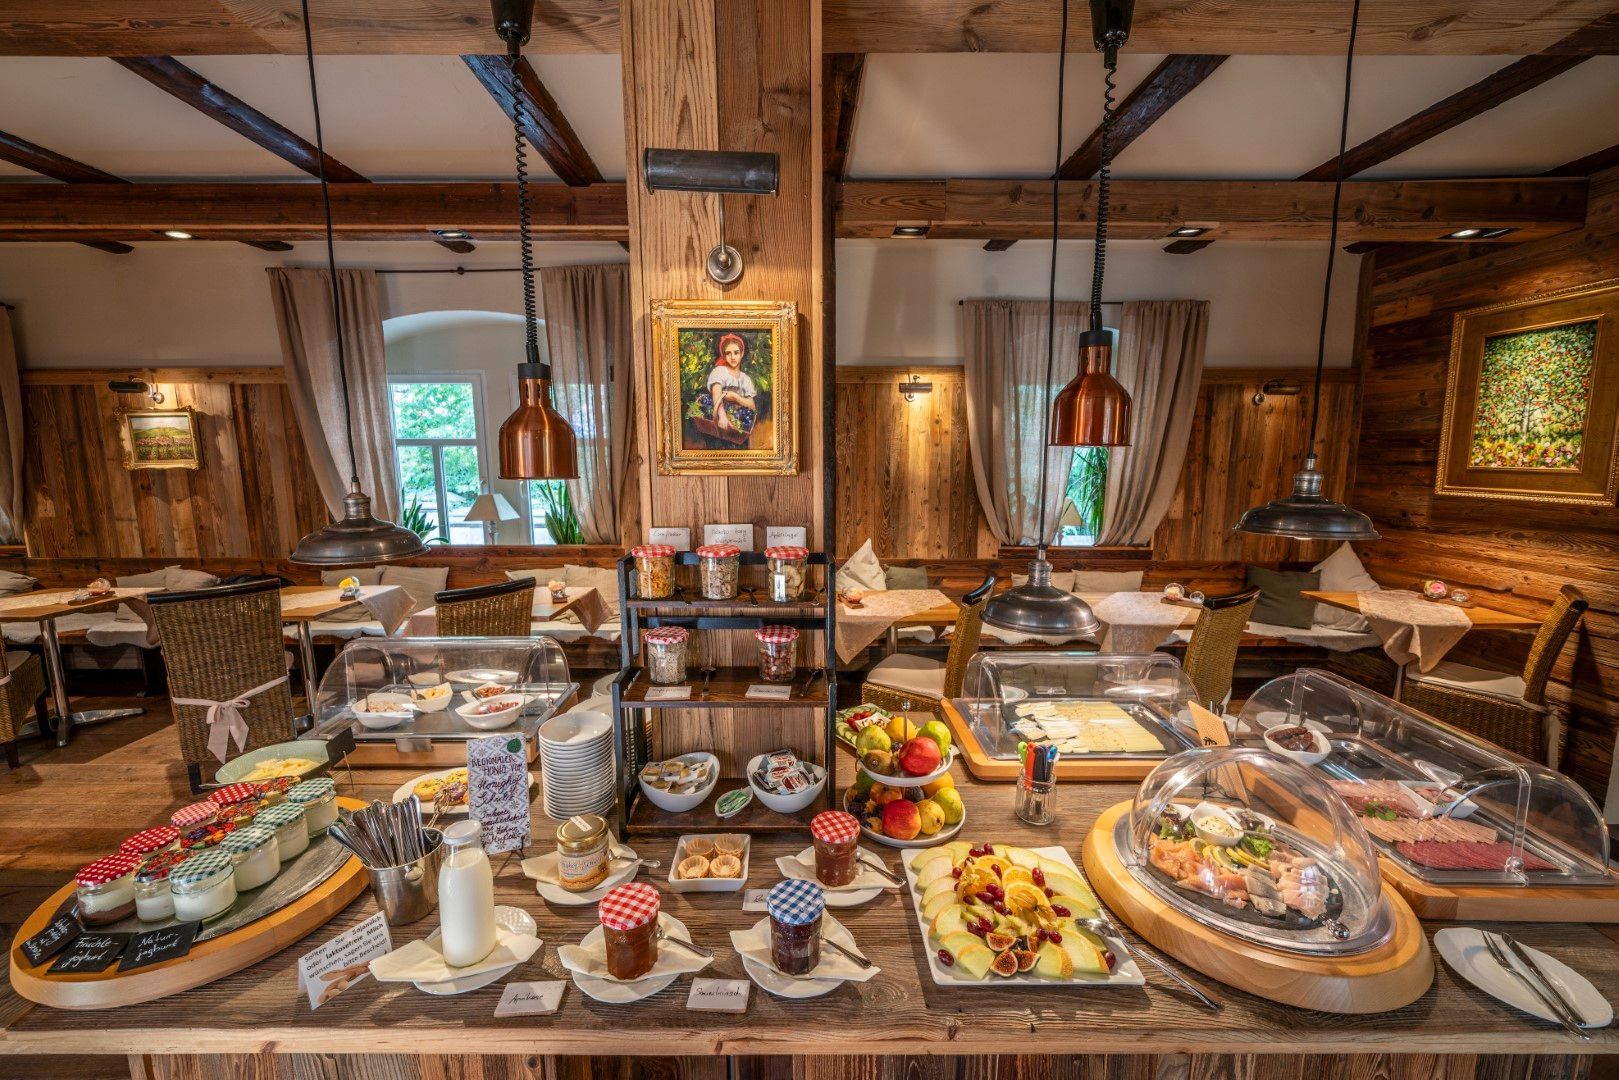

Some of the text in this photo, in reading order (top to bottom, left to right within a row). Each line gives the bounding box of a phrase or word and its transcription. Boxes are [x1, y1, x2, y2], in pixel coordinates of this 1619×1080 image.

[304, 946, 327, 963] Sollten
[334, 936, 345, 945] Sie
[306, 923, 384, 971] oder laktosefreie Milch
[344, 946, 362, 958] sagen
